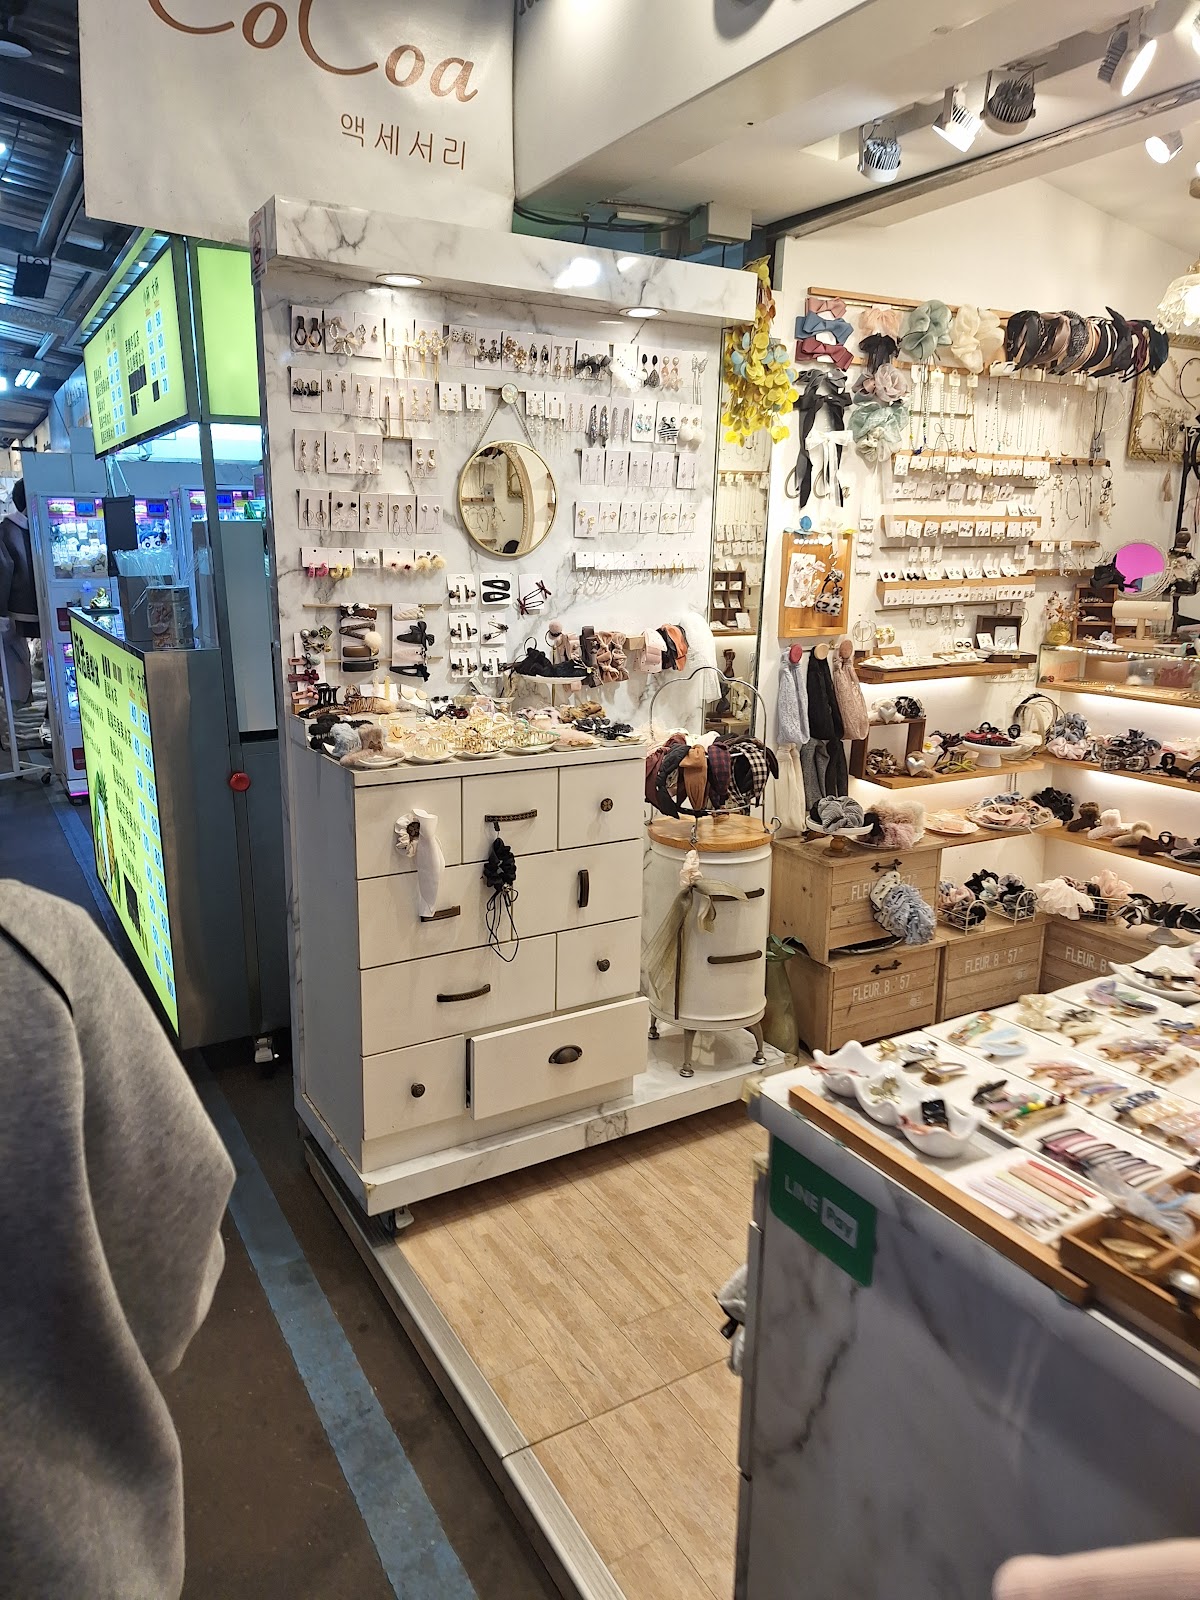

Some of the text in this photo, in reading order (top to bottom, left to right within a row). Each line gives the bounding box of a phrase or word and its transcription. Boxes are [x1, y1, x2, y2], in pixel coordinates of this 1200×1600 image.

[340, 112, 467, 171] 액세서리
[784, 1174, 855, 1240] LINE Pay
